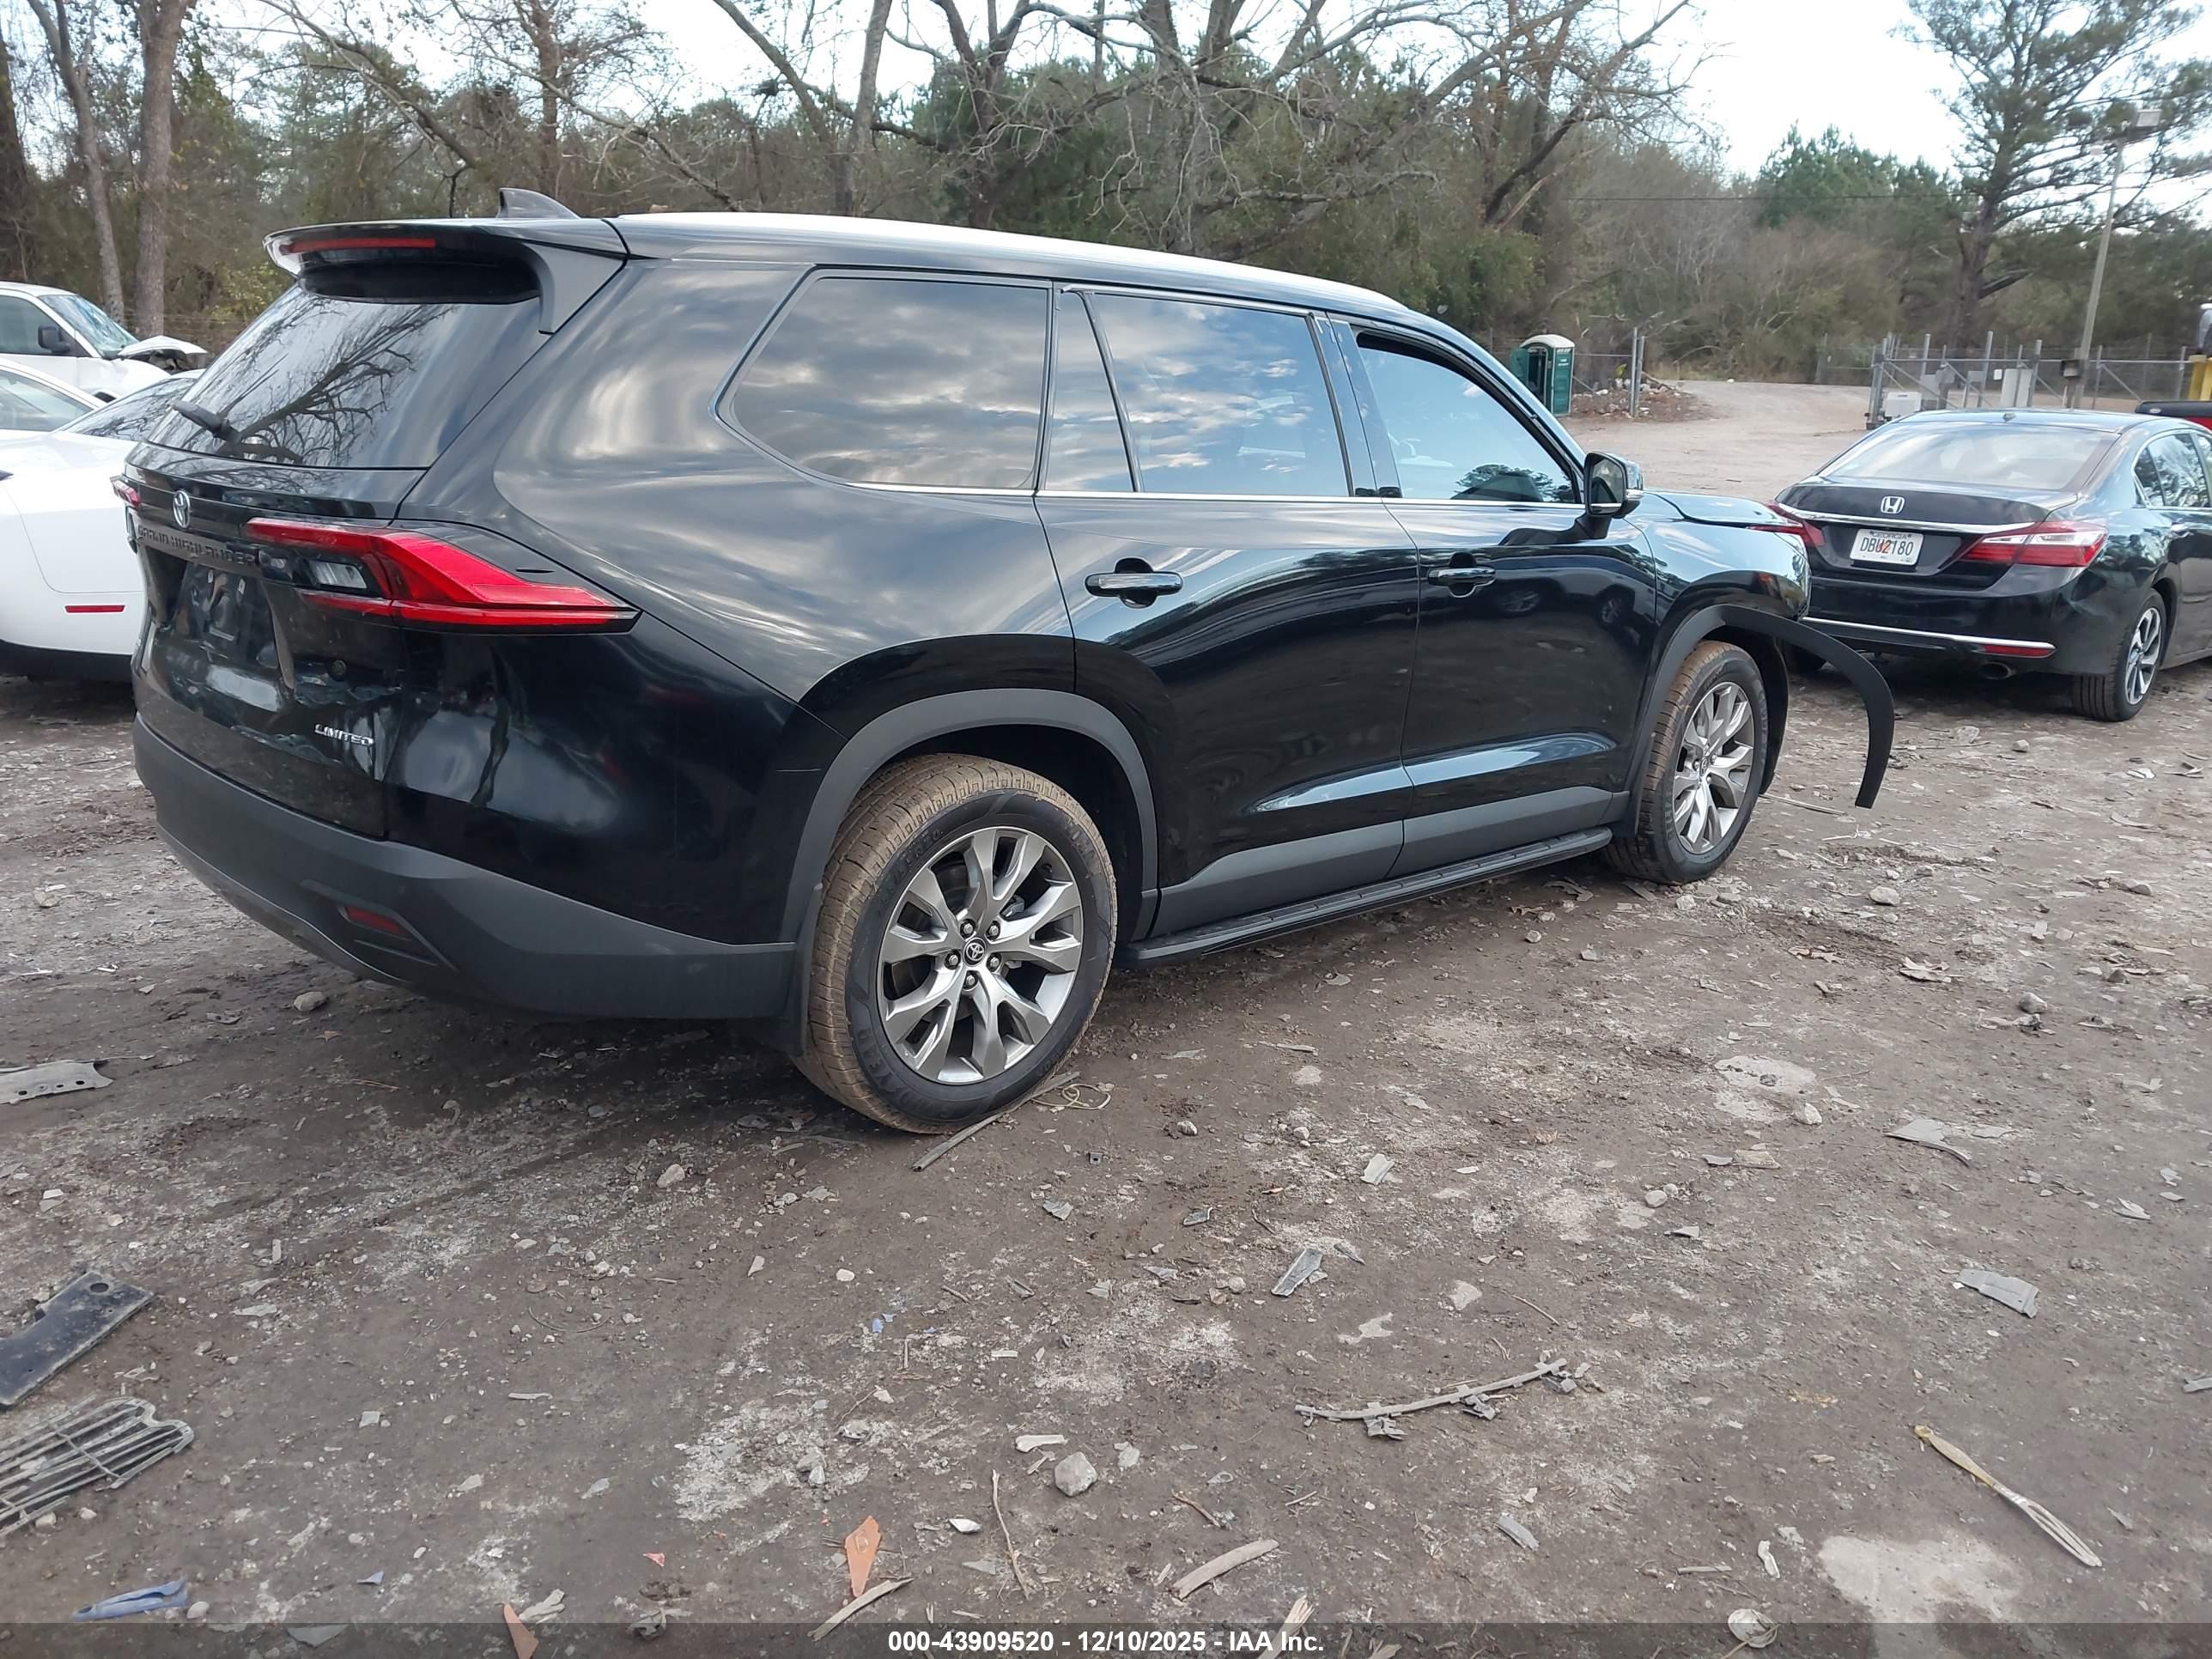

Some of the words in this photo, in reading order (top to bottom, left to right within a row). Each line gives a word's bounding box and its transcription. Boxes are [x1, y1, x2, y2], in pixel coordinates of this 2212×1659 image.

[137, 524, 170, 544] GRAND
[171, 535, 256, 565] HIGHLANDER
[1859, 537, 1914, 556] DBU2180
[314, 724, 374, 745] LIMITED
